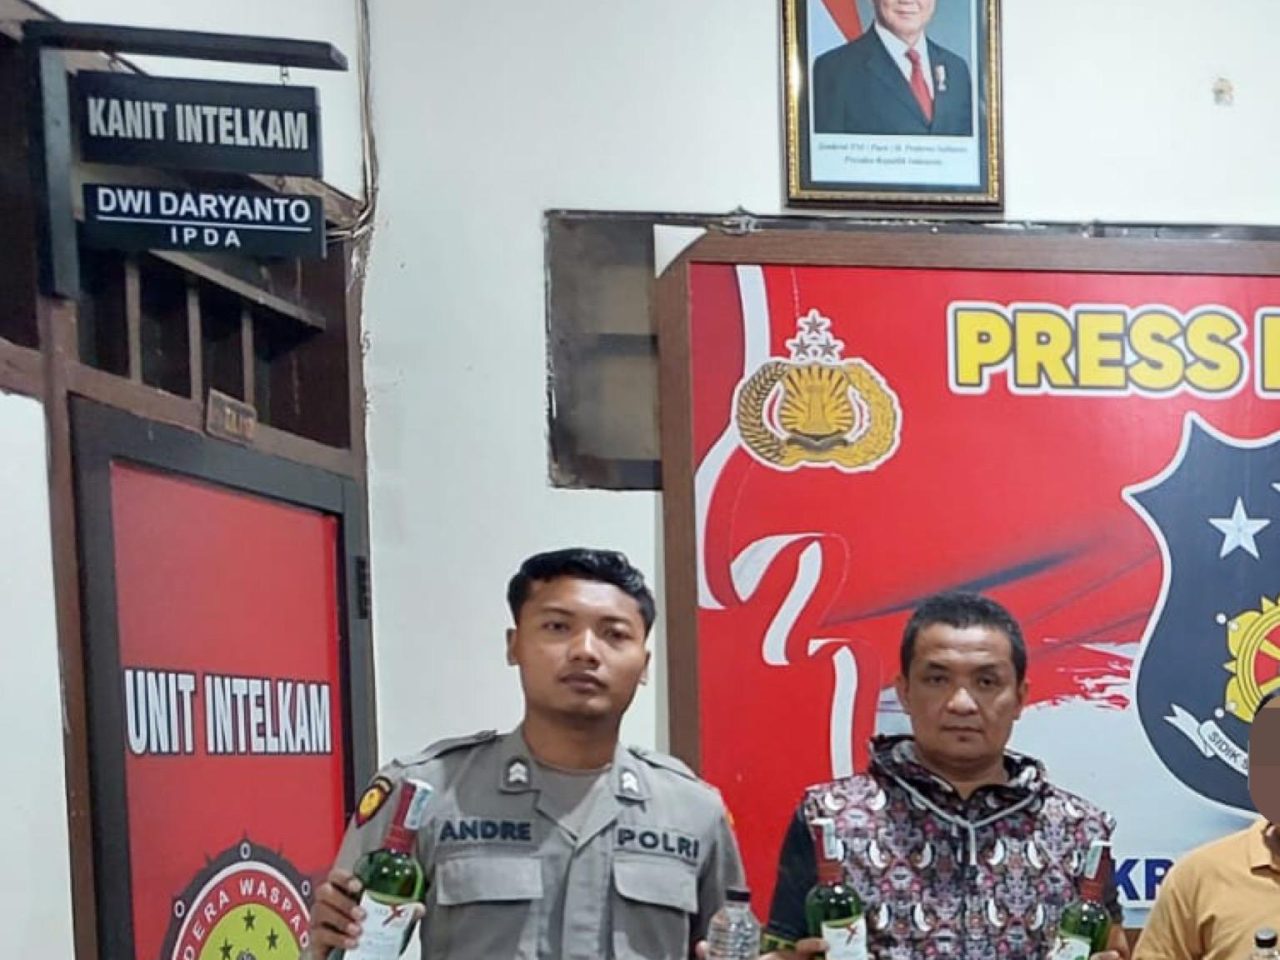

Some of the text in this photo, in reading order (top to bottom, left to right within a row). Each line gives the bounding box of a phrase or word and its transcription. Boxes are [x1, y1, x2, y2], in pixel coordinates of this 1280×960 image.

[87, 96, 309, 150] KANIT INTELKAM
[97, 187, 311, 223] DWI DARYANTO
[171, 226, 242, 248] IPDA
[951, 304, 1245, 394] PRESS
[124, 669, 332, 756] UNIT INTELKAM
[439, 819, 532, 843] ANDRE
[617, 828, 700, 860] POLRI
[239, 879, 310, 949] WASPAD
